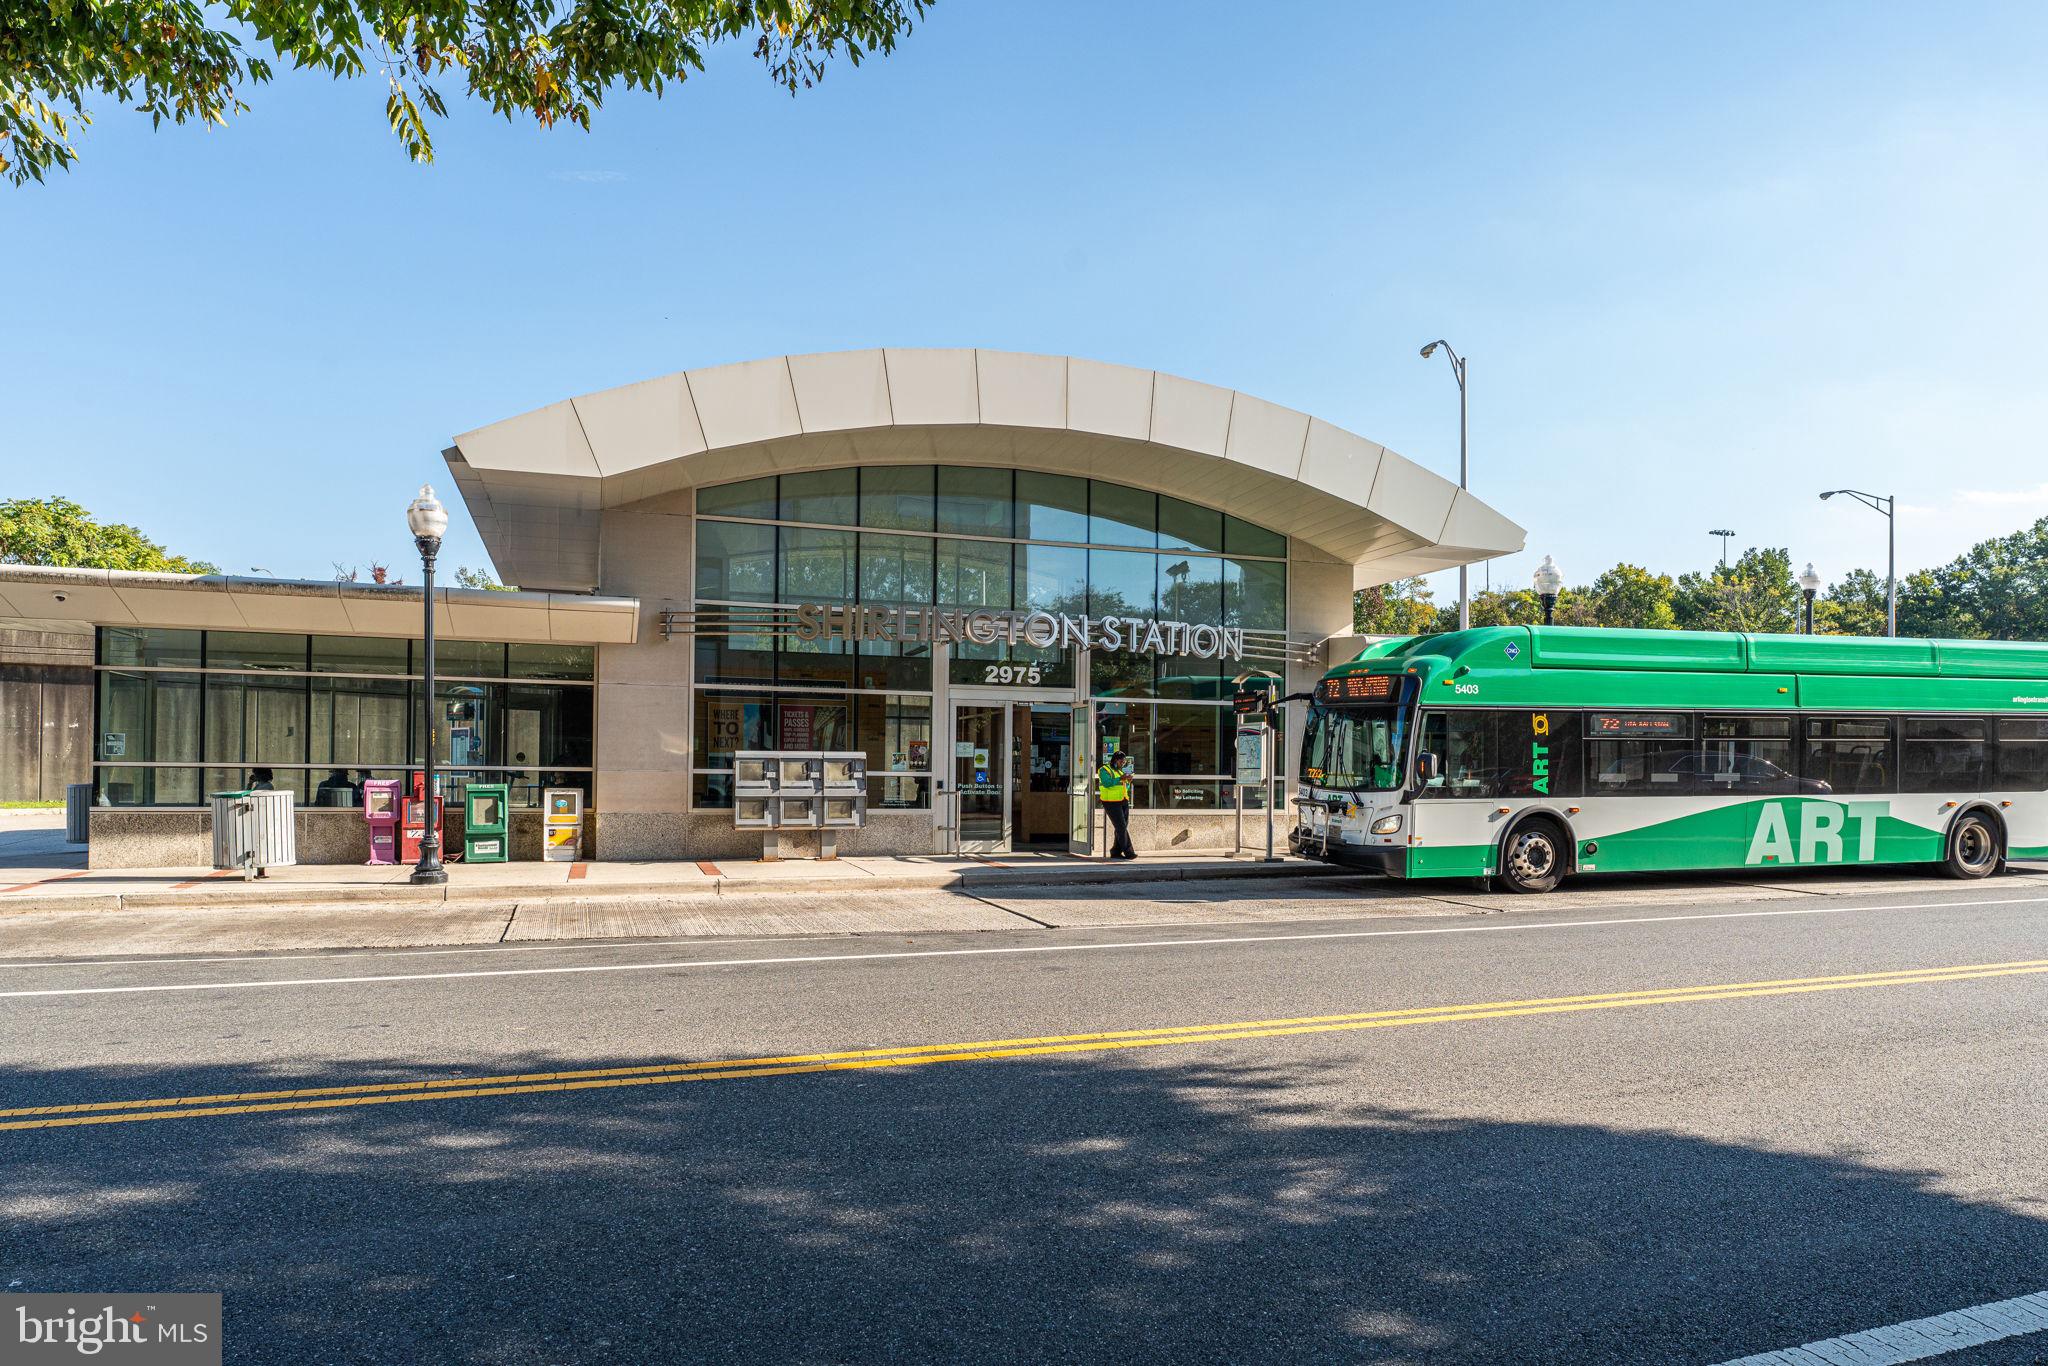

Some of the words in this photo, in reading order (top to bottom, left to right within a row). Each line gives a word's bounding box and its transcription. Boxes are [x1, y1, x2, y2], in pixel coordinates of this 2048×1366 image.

[796, 603, 1090, 651] SHIRLINGTON
[1099, 615, 1243, 662] STATION
[984, 665, 1041, 685] 2975
[1455, 684, 1479, 694] 5403
[713, 709, 739, 720] WHERE
[713, 721, 739, 735] TO
[784, 718, 809, 727] PASSES
[1600, 717, 1621, 730] 72
[713, 737, 739, 749] NEXT?
[1532, 742, 1549, 795] ART
[1745, 800, 1890, 864] ART
